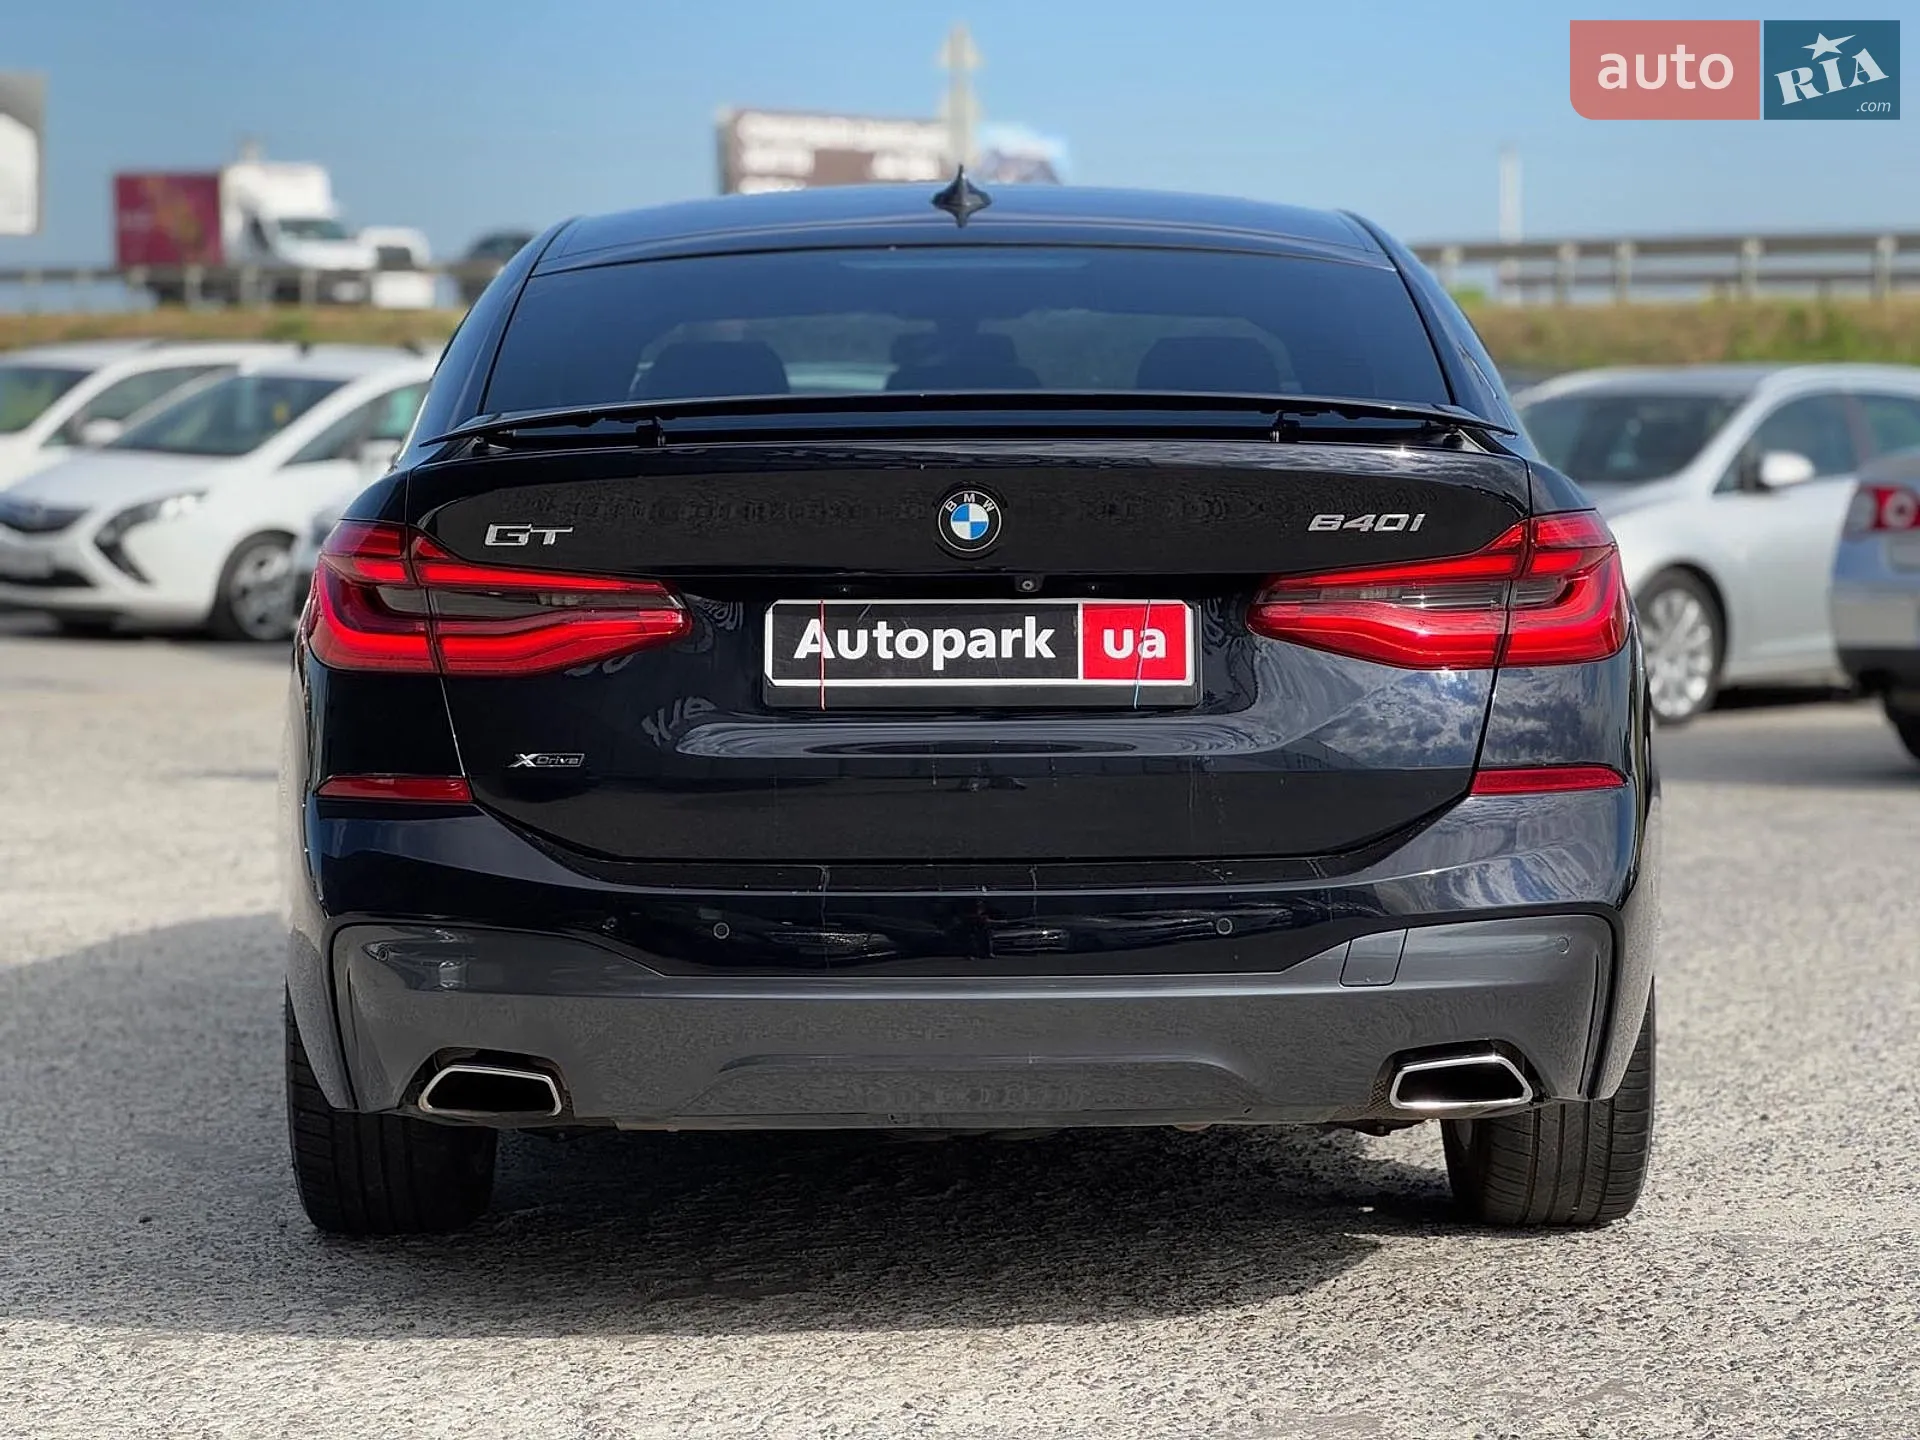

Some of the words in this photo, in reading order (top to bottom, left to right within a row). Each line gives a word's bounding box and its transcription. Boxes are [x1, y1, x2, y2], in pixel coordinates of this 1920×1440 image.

[945, 493, 995, 513] BMW
[485, 523, 573, 546] GT
[793, 616, 1056, 671] Autopark
[1102, 627, 1166, 659] ua
